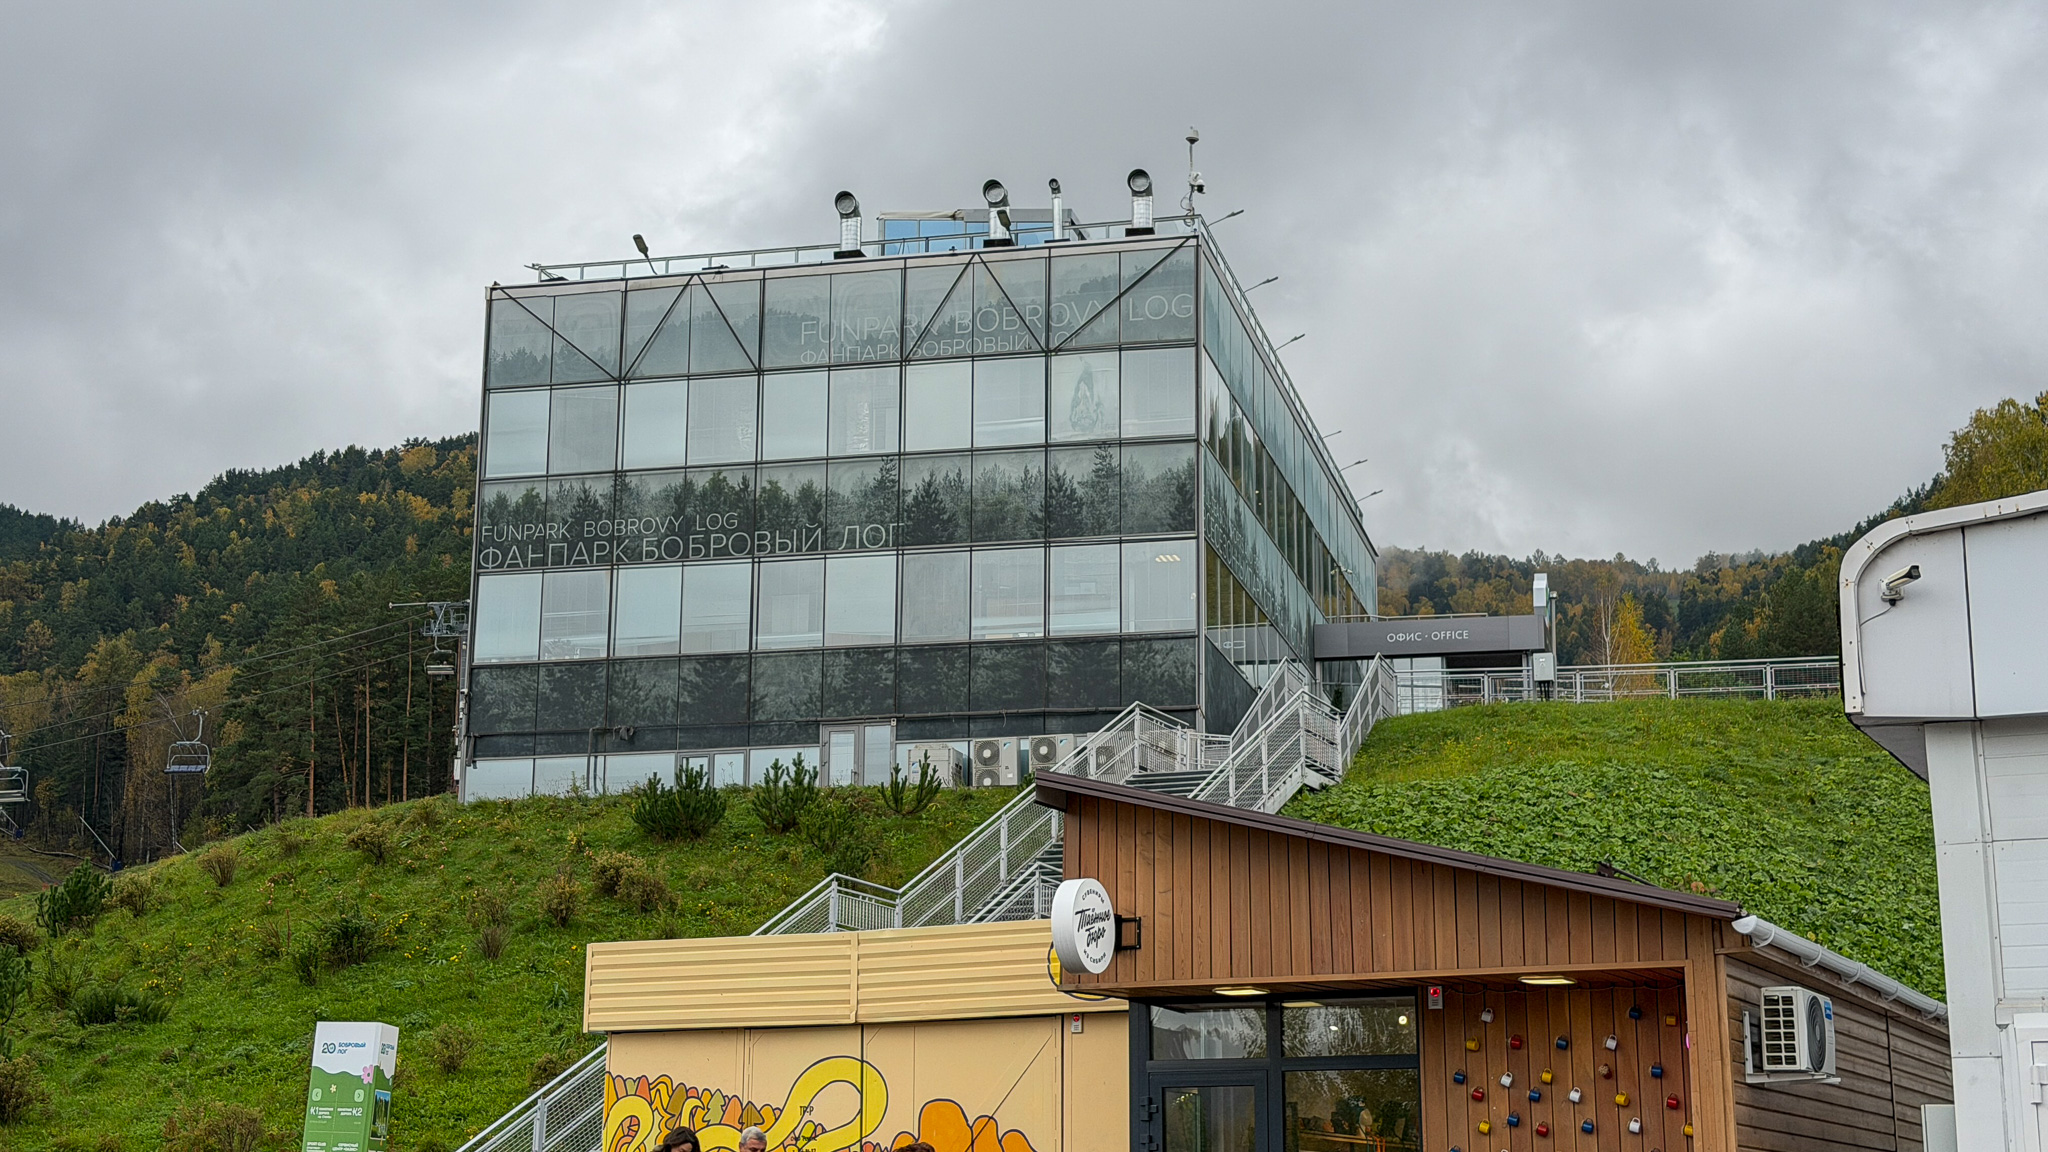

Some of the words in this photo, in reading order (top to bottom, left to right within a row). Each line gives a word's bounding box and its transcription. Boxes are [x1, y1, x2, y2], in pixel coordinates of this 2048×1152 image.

[801, 312, 938, 345] FUNPARK
[955, 300, 1112, 334] BOBROVY
[1128, 294, 1194, 322] LOG
[801, 343, 900, 364] ФАНПАРК
[481, 521, 571, 543] FUNPARK
[584, 515, 684, 538] BOBROVY
[696, 512, 739, 531] LOG
[479, 539, 630, 570] ФАНПАРК
[642, 523, 822, 562] БОБРОВЫЙ
[838, 523, 905, 551] ЛОГ
[1386, 632, 1422, 643] ОФИС
[1430, 630, 1469, 641] OFFICE
[321, 1042, 336, 1054] 20
